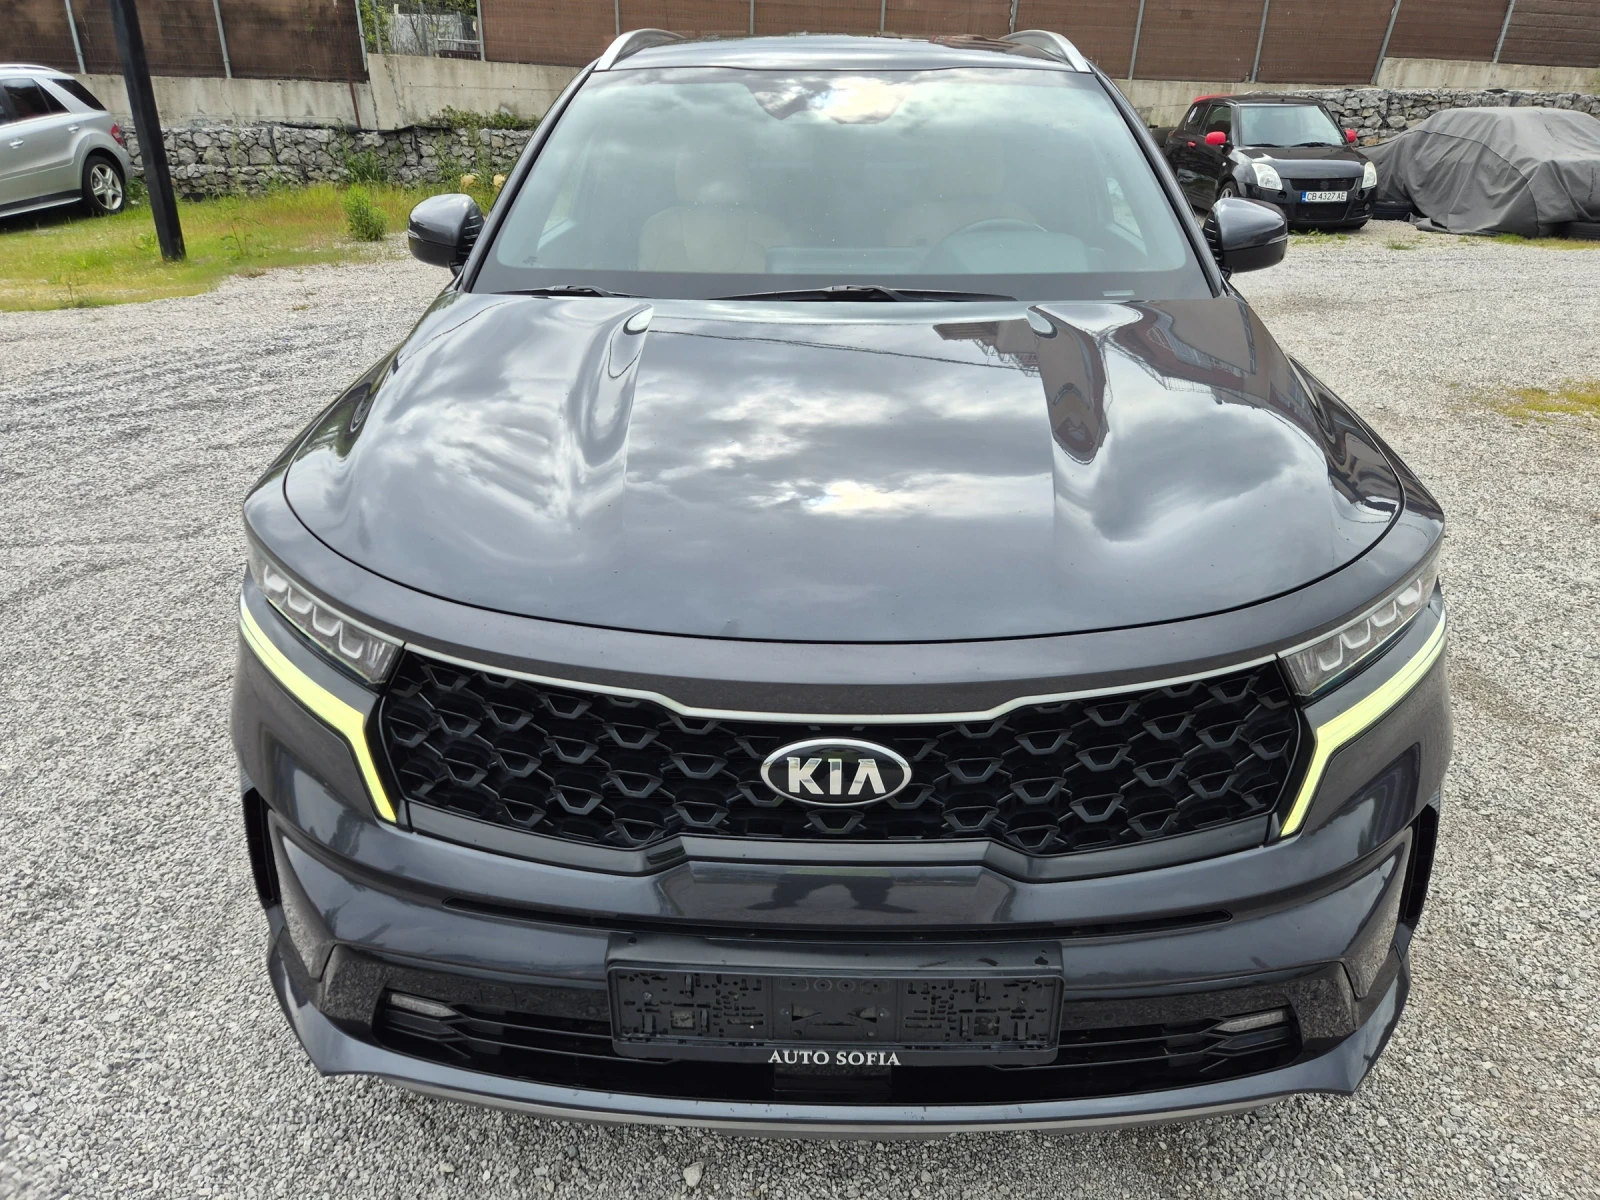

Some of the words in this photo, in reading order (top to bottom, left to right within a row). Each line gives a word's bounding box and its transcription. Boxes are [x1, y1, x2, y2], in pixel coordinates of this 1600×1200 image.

[1306, 192, 1317, 201] CB
[1318, 192, 1336, 201] 4327
[1337, 192, 1346, 200] AE
[786, 756, 887, 796] KIA
[767, 1049, 830, 1065] AUTO
[836, 1051, 901, 1066] SOFIA
